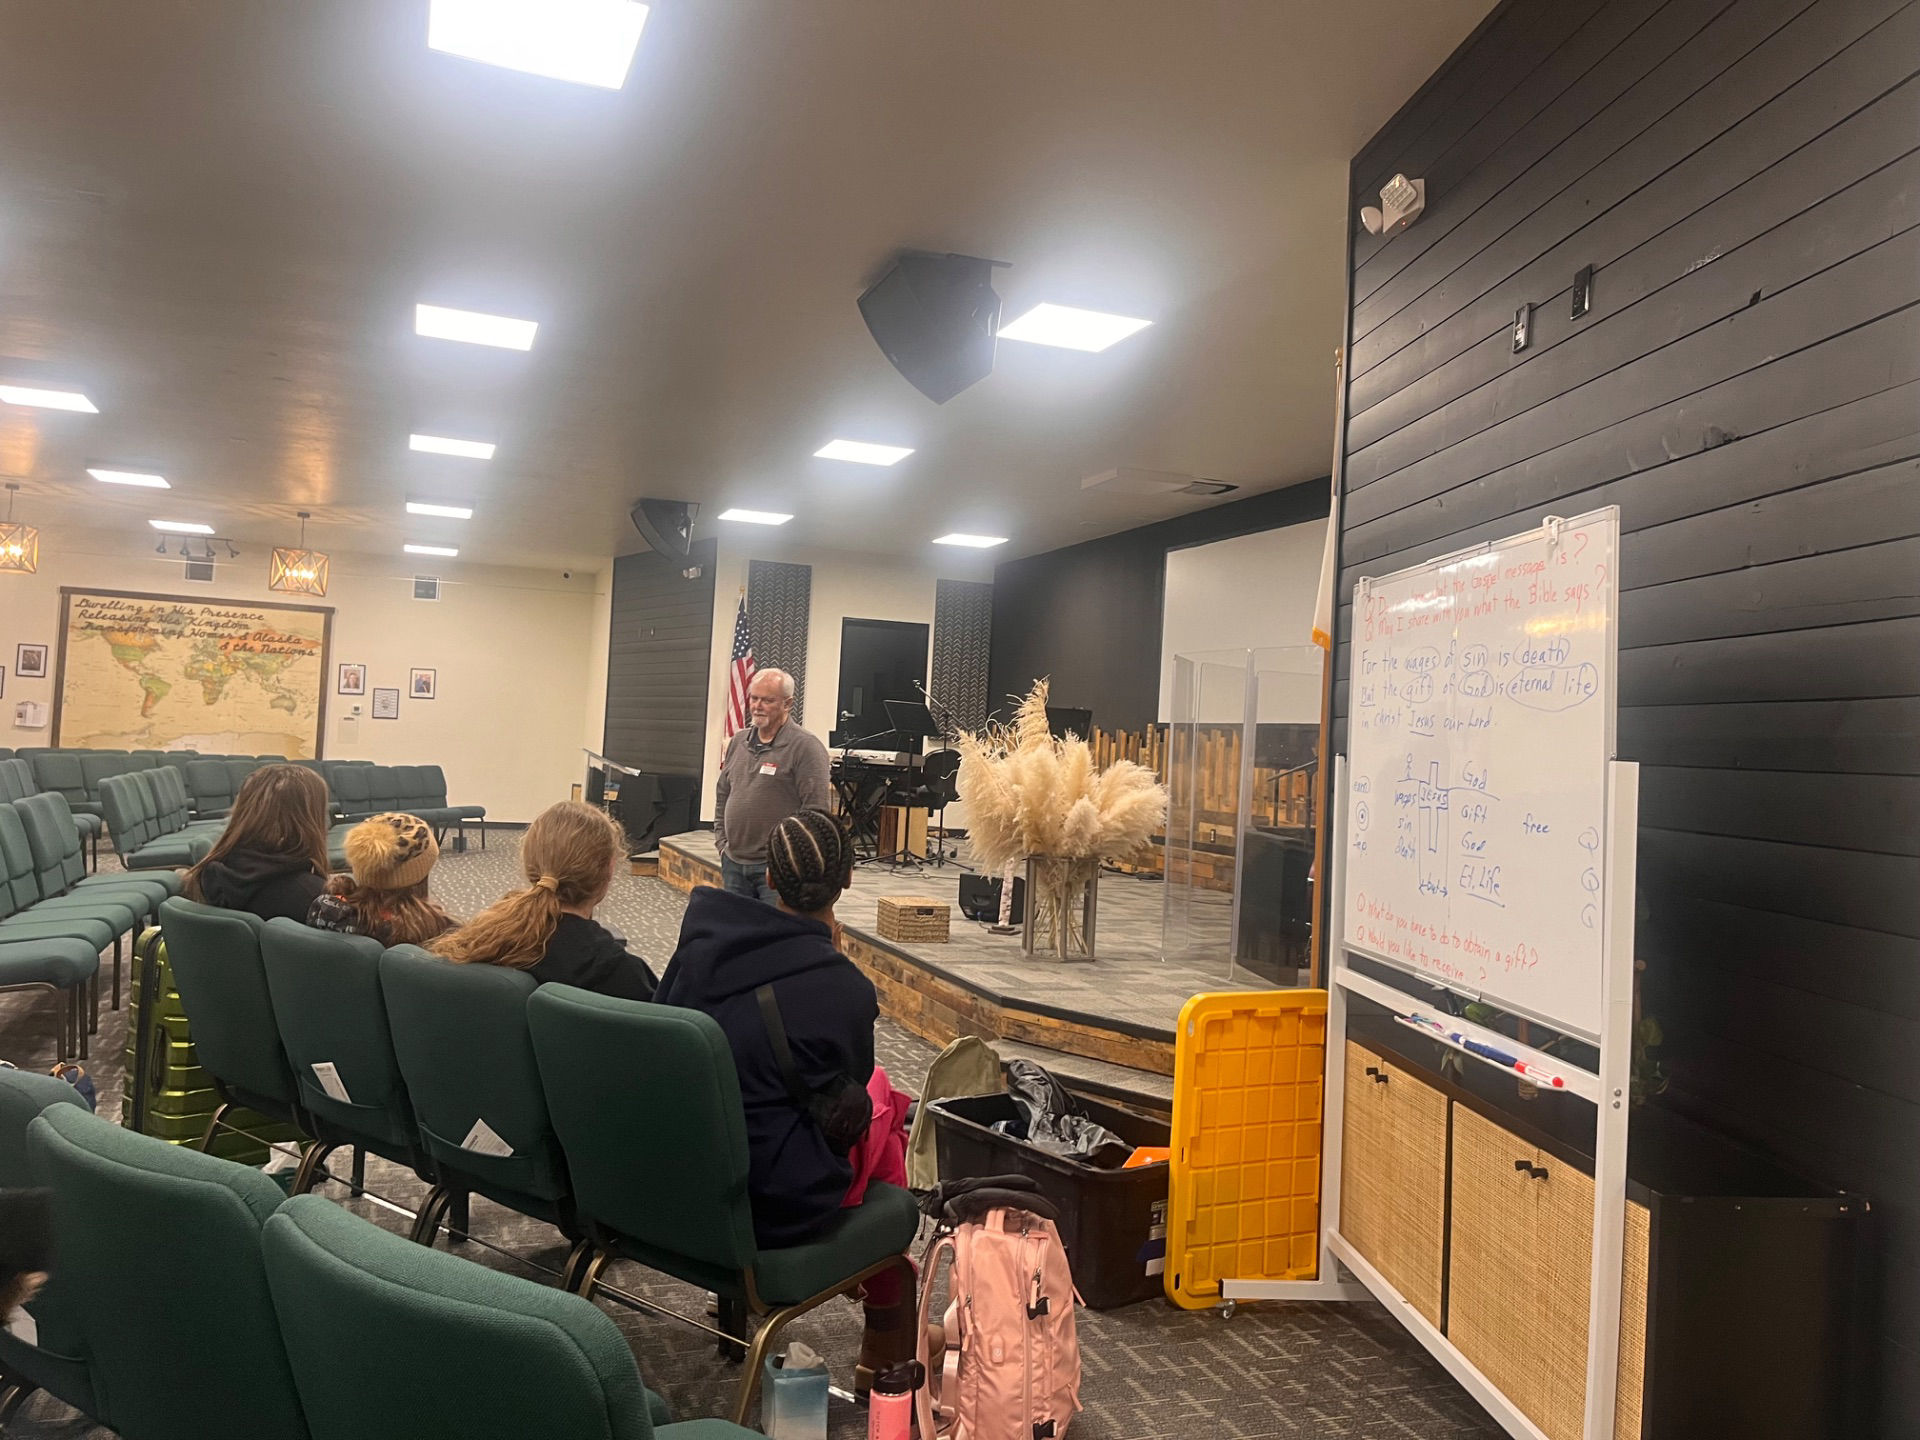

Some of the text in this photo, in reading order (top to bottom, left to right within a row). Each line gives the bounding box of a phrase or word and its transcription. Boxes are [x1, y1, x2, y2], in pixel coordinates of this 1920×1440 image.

[1505, 560, 1546, 581] message
[75, 598, 265, 621] Dwelling in His Presence
[79, 609, 251, 631] Releasing His Kingdom
[1378, 617, 1393, 638] May
[1397, 616, 1403, 632] I
[1408, 614, 1430, 630] share
[1433, 607, 1451, 623] with
[1455, 607, 1470, 625] you
[1474, 592, 1499, 616] what
[1504, 589, 1520, 610] the
[1528, 580, 1558, 604] Bible
[81, 621, 186, 639] Transforming
[189, 628, 237, 640] Homer
[253, 632, 303, 645] Alaska
[233, 642, 256, 653] the
[261, 644, 316, 657] Nations
[1361, 635, 1565, 675] For the wages of sin is death
[1383, 674, 1398, 699] the
[1407, 673, 1432, 708] gift
[1443, 673, 1456, 694] of
[1463, 672, 1489, 697] God
[1495, 674, 1505, 696] is
[1510, 671, 1554, 695] eternal
[1562, 664, 1592, 697] life
[1407, 710, 1436, 729] Jesus
[1443, 717, 1464, 732] our
[1462, 761, 1488, 790] God
[1461, 804, 1487, 824] Gift
[1522, 812, 1550, 835] free
[1461, 831, 1487, 851] God
[1479, 865, 1501, 897] Life
[1368, 898, 1385, 920] What
[1385, 901, 1393, 920] do
[1395, 915, 1408, 934] you
[1429, 923, 1437, 941] to
[1440, 926, 1449, 944] do
[1452, 930, 1460, 949] to
[1464, 930, 1491, 960] obtain
[1495, 951, 1501, 961] a
[1387, 940, 1400, 955] you
[1402, 938, 1417, 960] like
[1419, 946, 1428, 967] to
